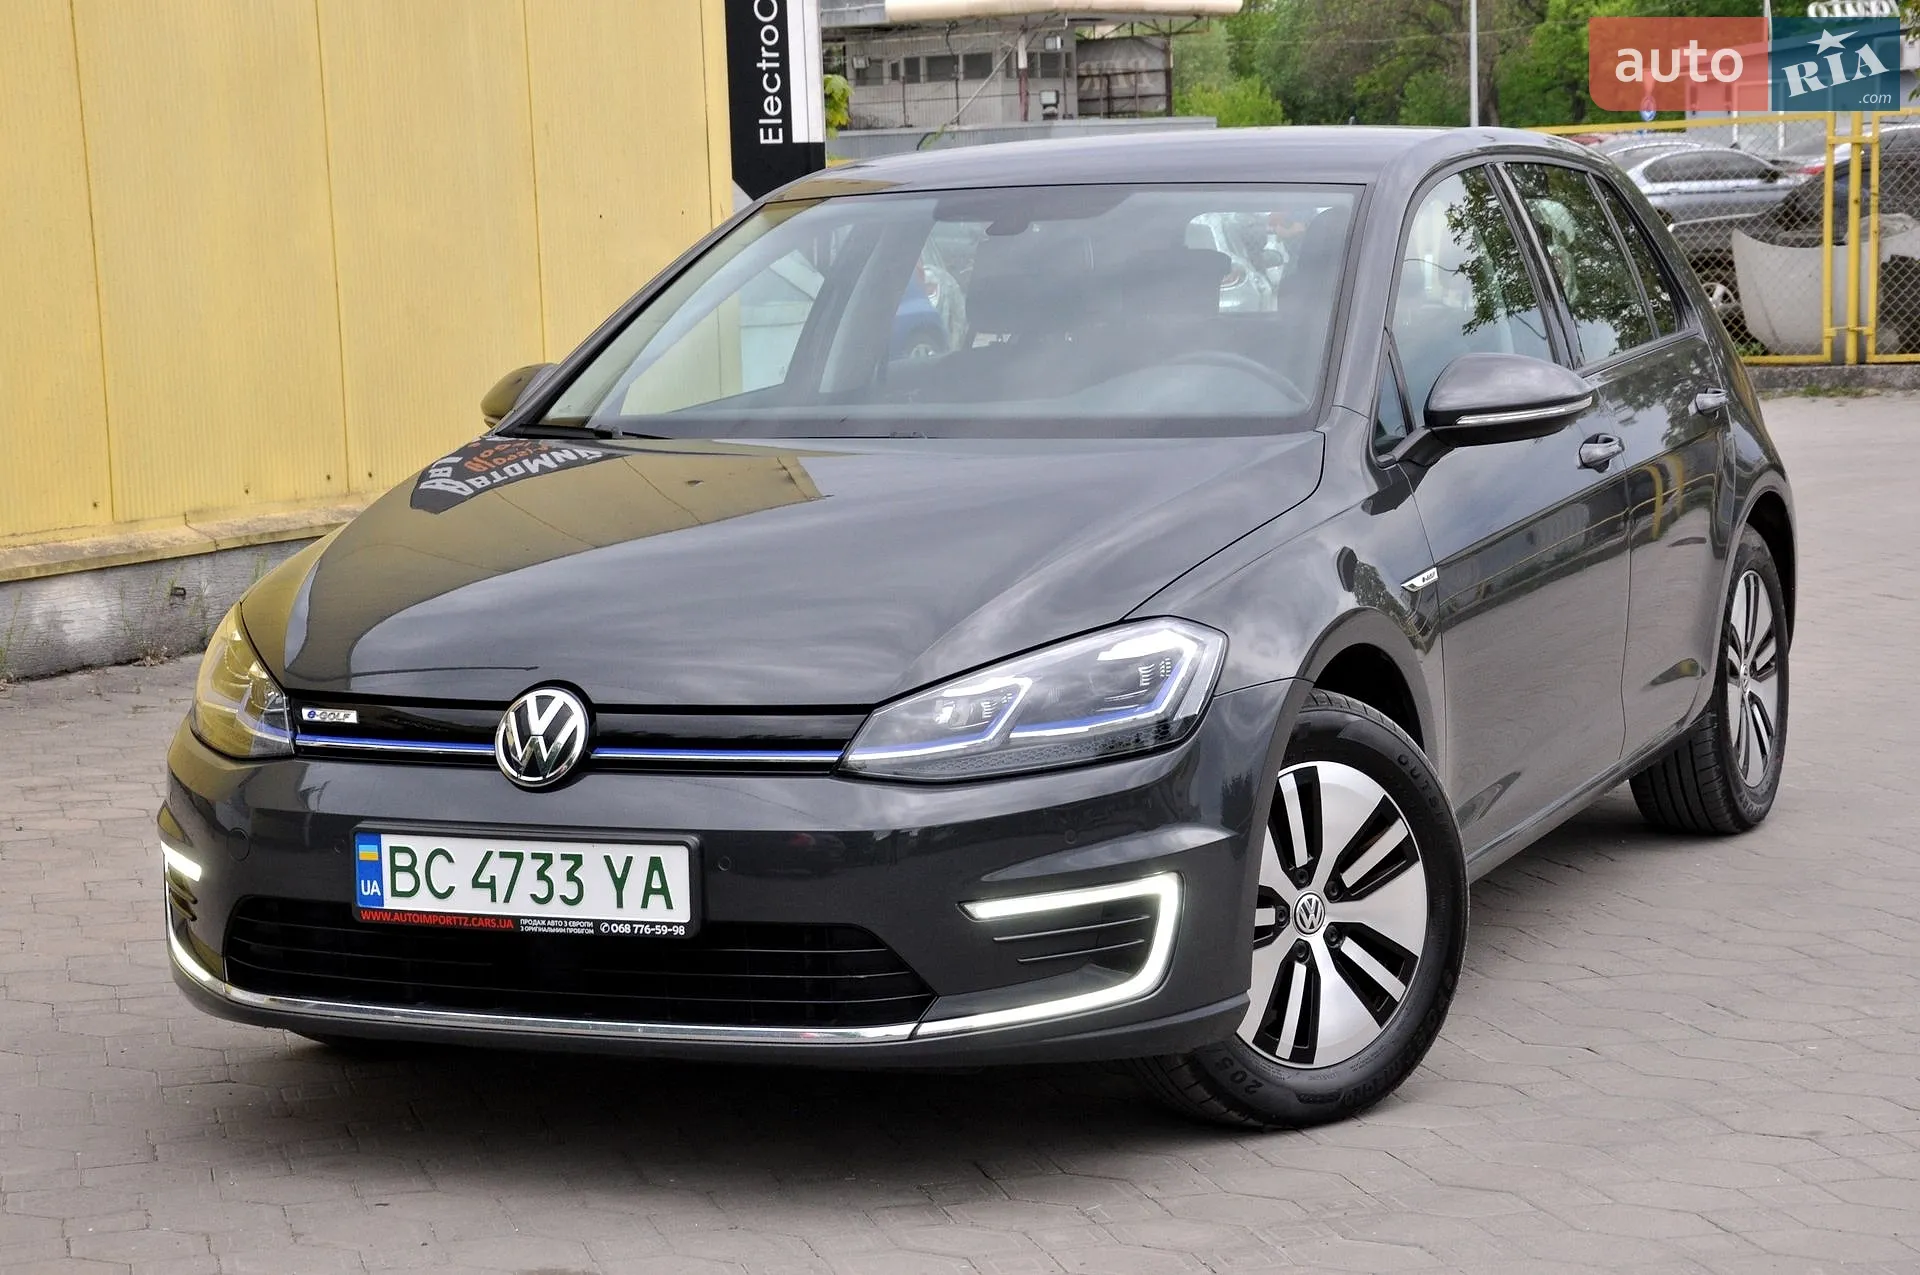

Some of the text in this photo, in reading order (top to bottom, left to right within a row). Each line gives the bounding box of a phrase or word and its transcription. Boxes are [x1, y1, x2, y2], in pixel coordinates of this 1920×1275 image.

[753, 0, 783, 144] ElectroC
[388, 844, 674, 910] BC 4733 YA
[361, 879, 381, 897] UA
[520, 918, 546, 927] ПРОДАЖ
[547, 919, 563, 927] АВТО
[610, 923, 686, 936] 068 776-59-98
